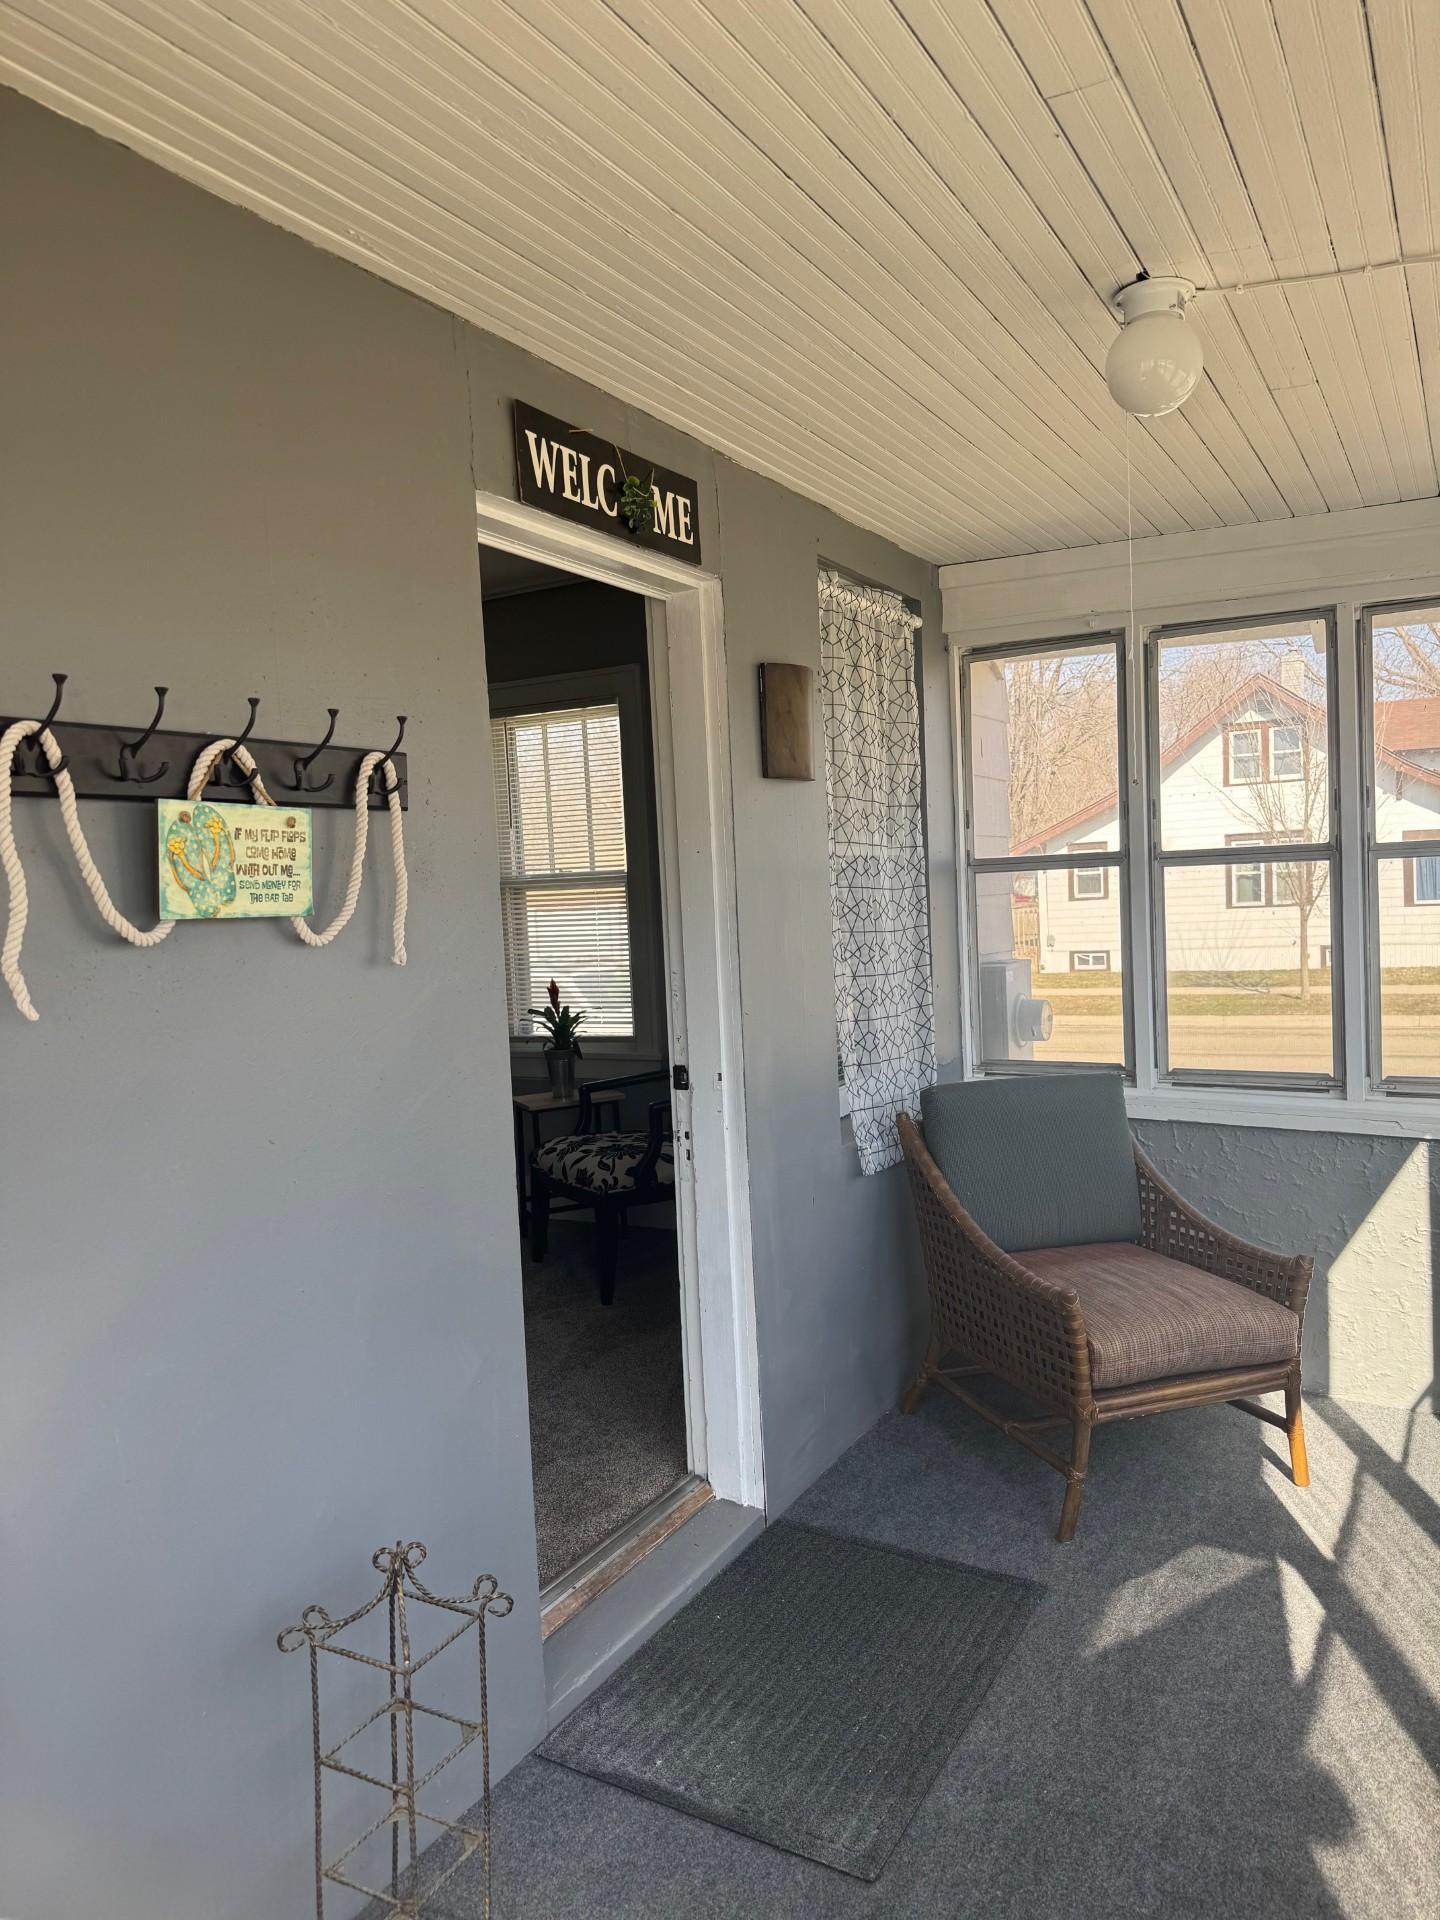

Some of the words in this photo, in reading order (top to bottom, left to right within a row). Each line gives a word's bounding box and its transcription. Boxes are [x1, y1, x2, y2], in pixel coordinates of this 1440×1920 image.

[524, 429, 694, 545] WELCME
[260, 829, 280, 843] FLIP
[281, 830, 306, 843] FLOPS
[261, 864, 279, 876] OUT
[288, 880, 301, 891] FOR
